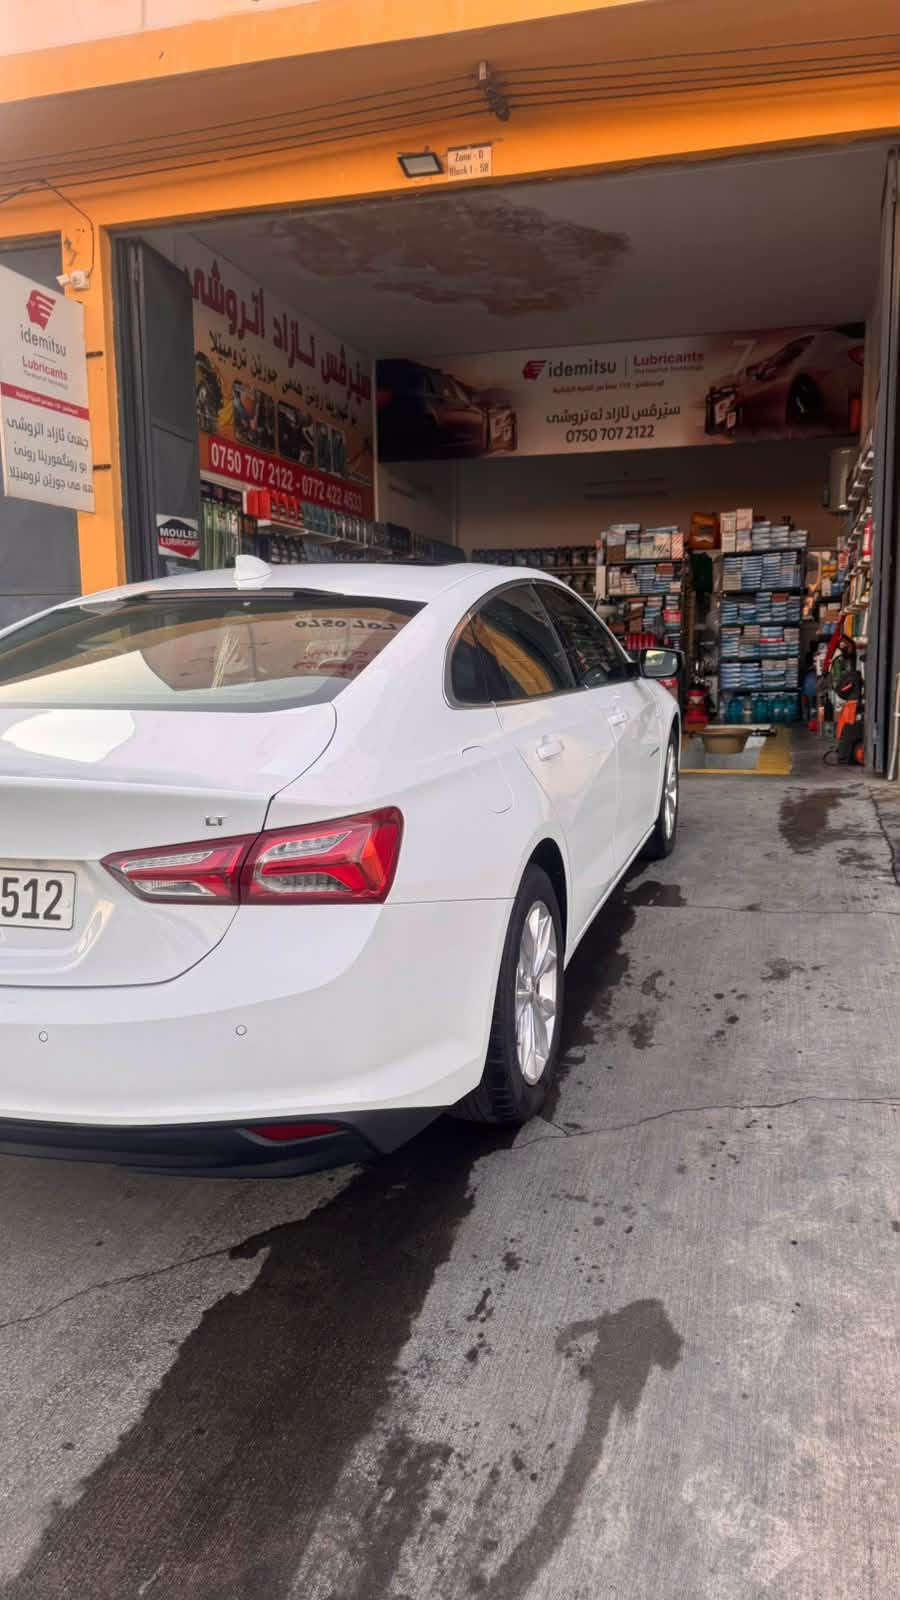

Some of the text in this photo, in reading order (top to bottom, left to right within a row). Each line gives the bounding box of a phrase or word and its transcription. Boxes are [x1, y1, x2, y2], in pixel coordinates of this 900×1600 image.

[20, 324, 67, 357] idemitsu
[22, 355, 68, 381] Lubricants
[549, 359, 617, 378] idemitsu
[633, 351, 704, 367] Lubricants
[565, 425, 655, 443] 0750 707 2122
[211, 443, 241, 473] 0750
[245, 455, 265, 480] 707
[268, 463, 294, 490] 2122
[302, 475, 325, 499] 0772
[1, 876, 63, 921] 512
